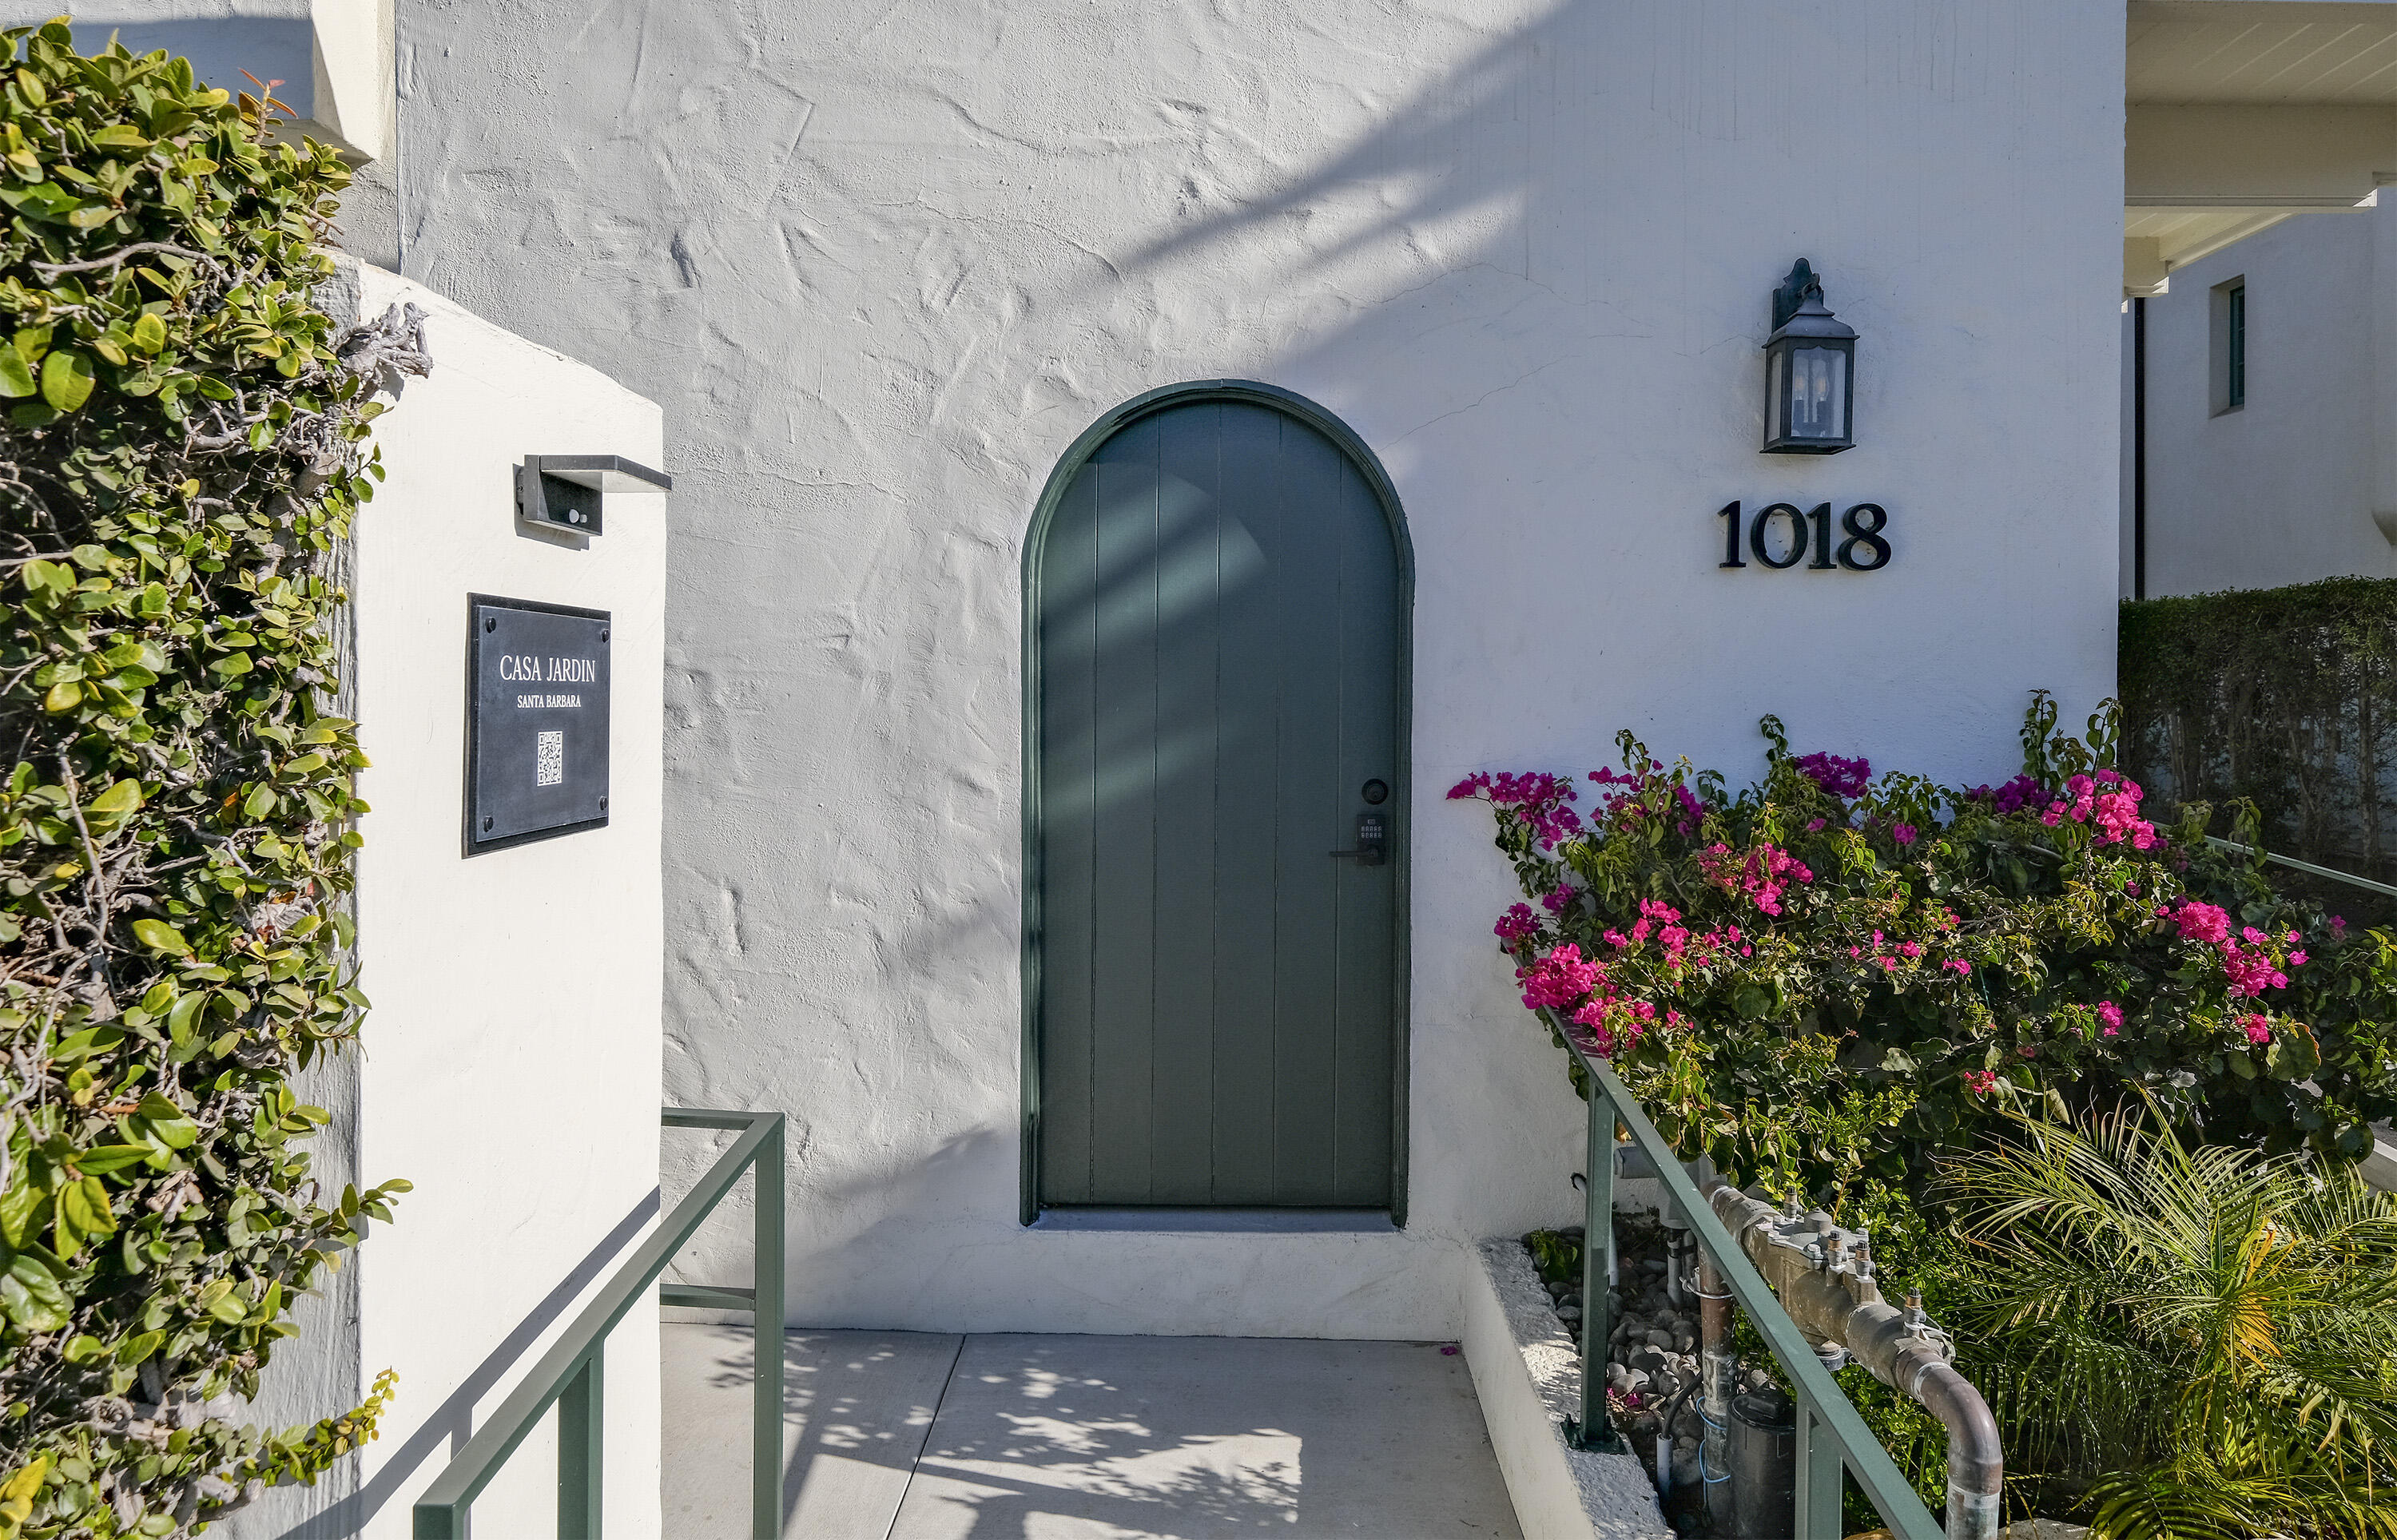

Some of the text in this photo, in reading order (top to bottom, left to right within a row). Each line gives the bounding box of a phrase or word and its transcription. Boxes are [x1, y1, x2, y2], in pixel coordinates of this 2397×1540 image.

[1718, 500, 1892, 571] 1018
[499, 655, 595, 682] CASA JARDIN
[517, 695, 581, 708] SANTA BARBARA
